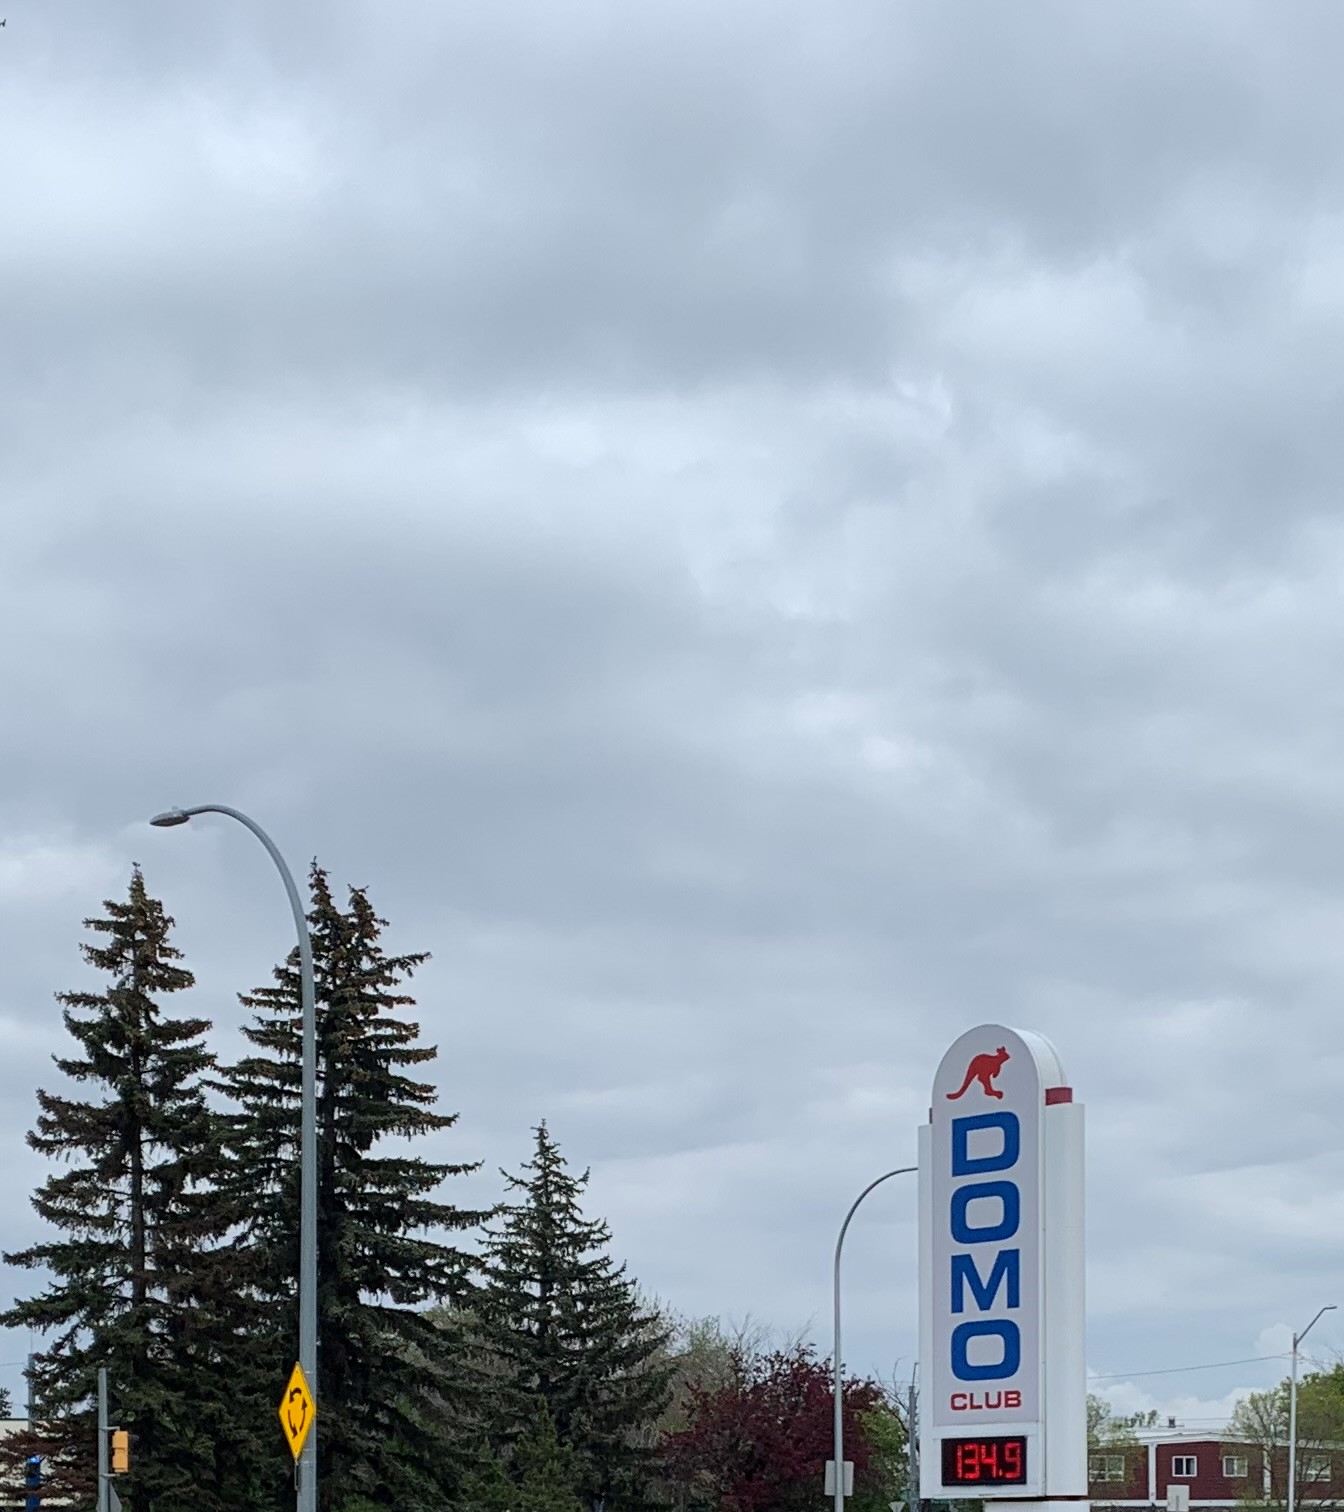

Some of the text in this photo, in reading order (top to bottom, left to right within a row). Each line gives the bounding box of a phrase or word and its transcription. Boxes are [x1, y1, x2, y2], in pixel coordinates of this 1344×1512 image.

[950, 1110, 1020, 1382] DOMO
[950, 1390, 1022, 1410] CLUB
[956, 1441, 1023, 1480] 134.9
